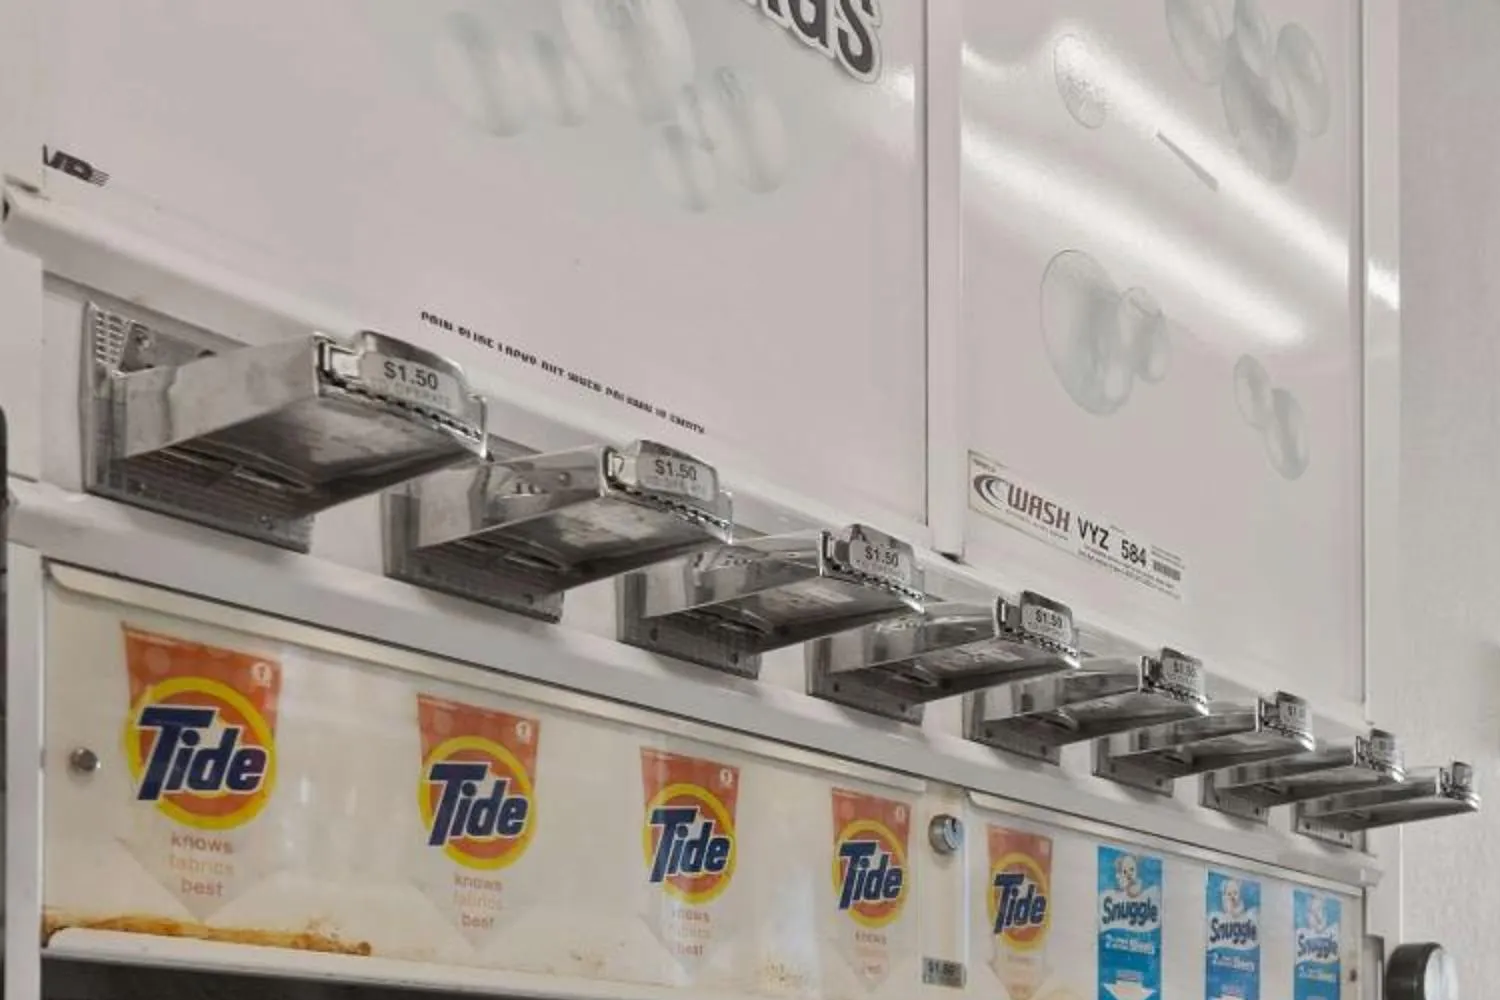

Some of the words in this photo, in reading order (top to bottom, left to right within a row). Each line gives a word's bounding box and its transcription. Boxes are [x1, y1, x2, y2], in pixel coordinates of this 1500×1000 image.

[383, 360, 439, 391] $1.50
[1007, 483, 1070, 533] WASH
[1078, 515, 1109, 551] VYZ
[1121, 539, 1147, 568] 584
[136, 705, 269, 801] Tide
[427, 762, 529, 847] Tide
[170, 832, 234, 855] knows
[648, 806, 731, 883] Tide
[180, 878, 225, 898] best
[838, 841, 904, 911] Tide
[993, 872, 1047, 935] Tide
[1101, 895, 1158, 927] Snuggle
[1208, 915, 1258, 944] Snuggle
